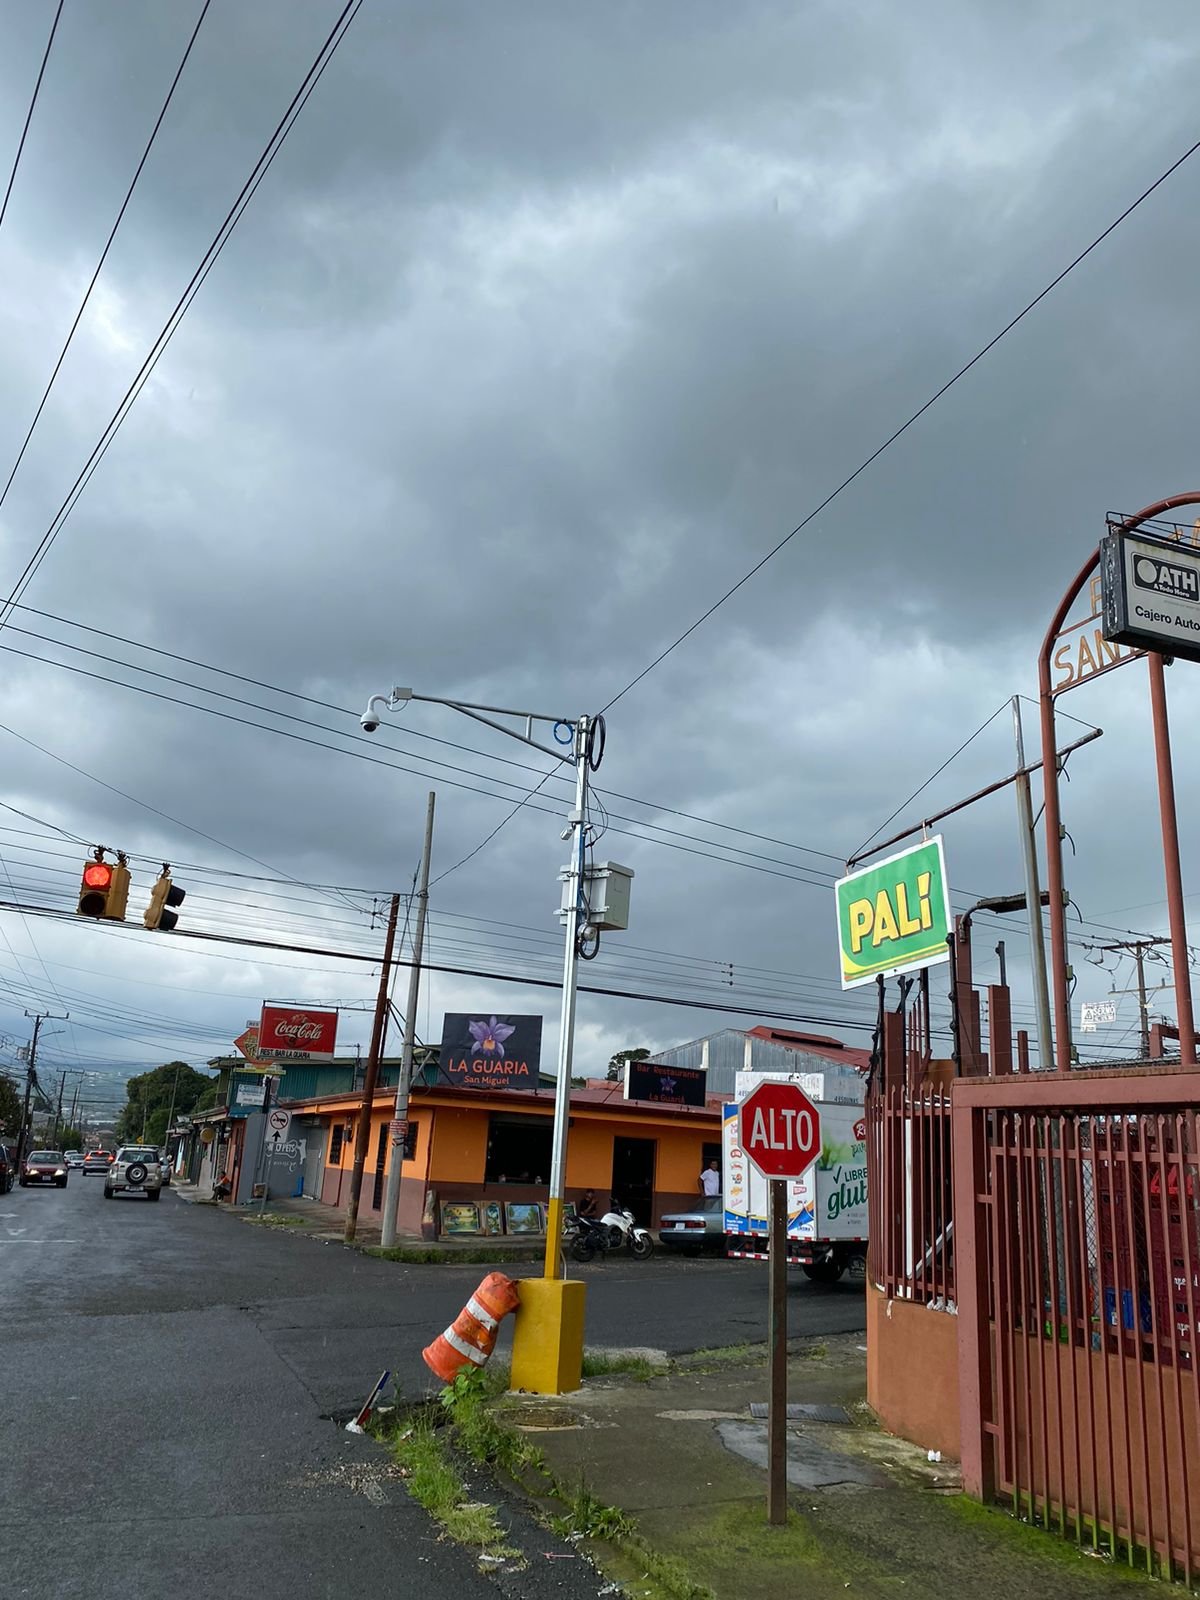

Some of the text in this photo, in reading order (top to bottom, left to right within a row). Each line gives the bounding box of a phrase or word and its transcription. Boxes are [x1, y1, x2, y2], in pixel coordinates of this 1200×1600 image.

[1158, 565, 1196, 593] ATH
[1158, 584, 1174, 594] Todo
[1135, 605, 1172, 625] Cajero
[274, 1020, 325, 1040] Coca-Cola
[448, 1058, 529, 1075] LA GUARIA
[637, 1064, 701, 1080] Bar Restaurante
[464, 1076, 509, 1086] San Miguel
[649, 1092, 659, 1101] La
[750, 1107, 813, 1153] ALTO
[845, 1167, 868, 1183] LIBRE
